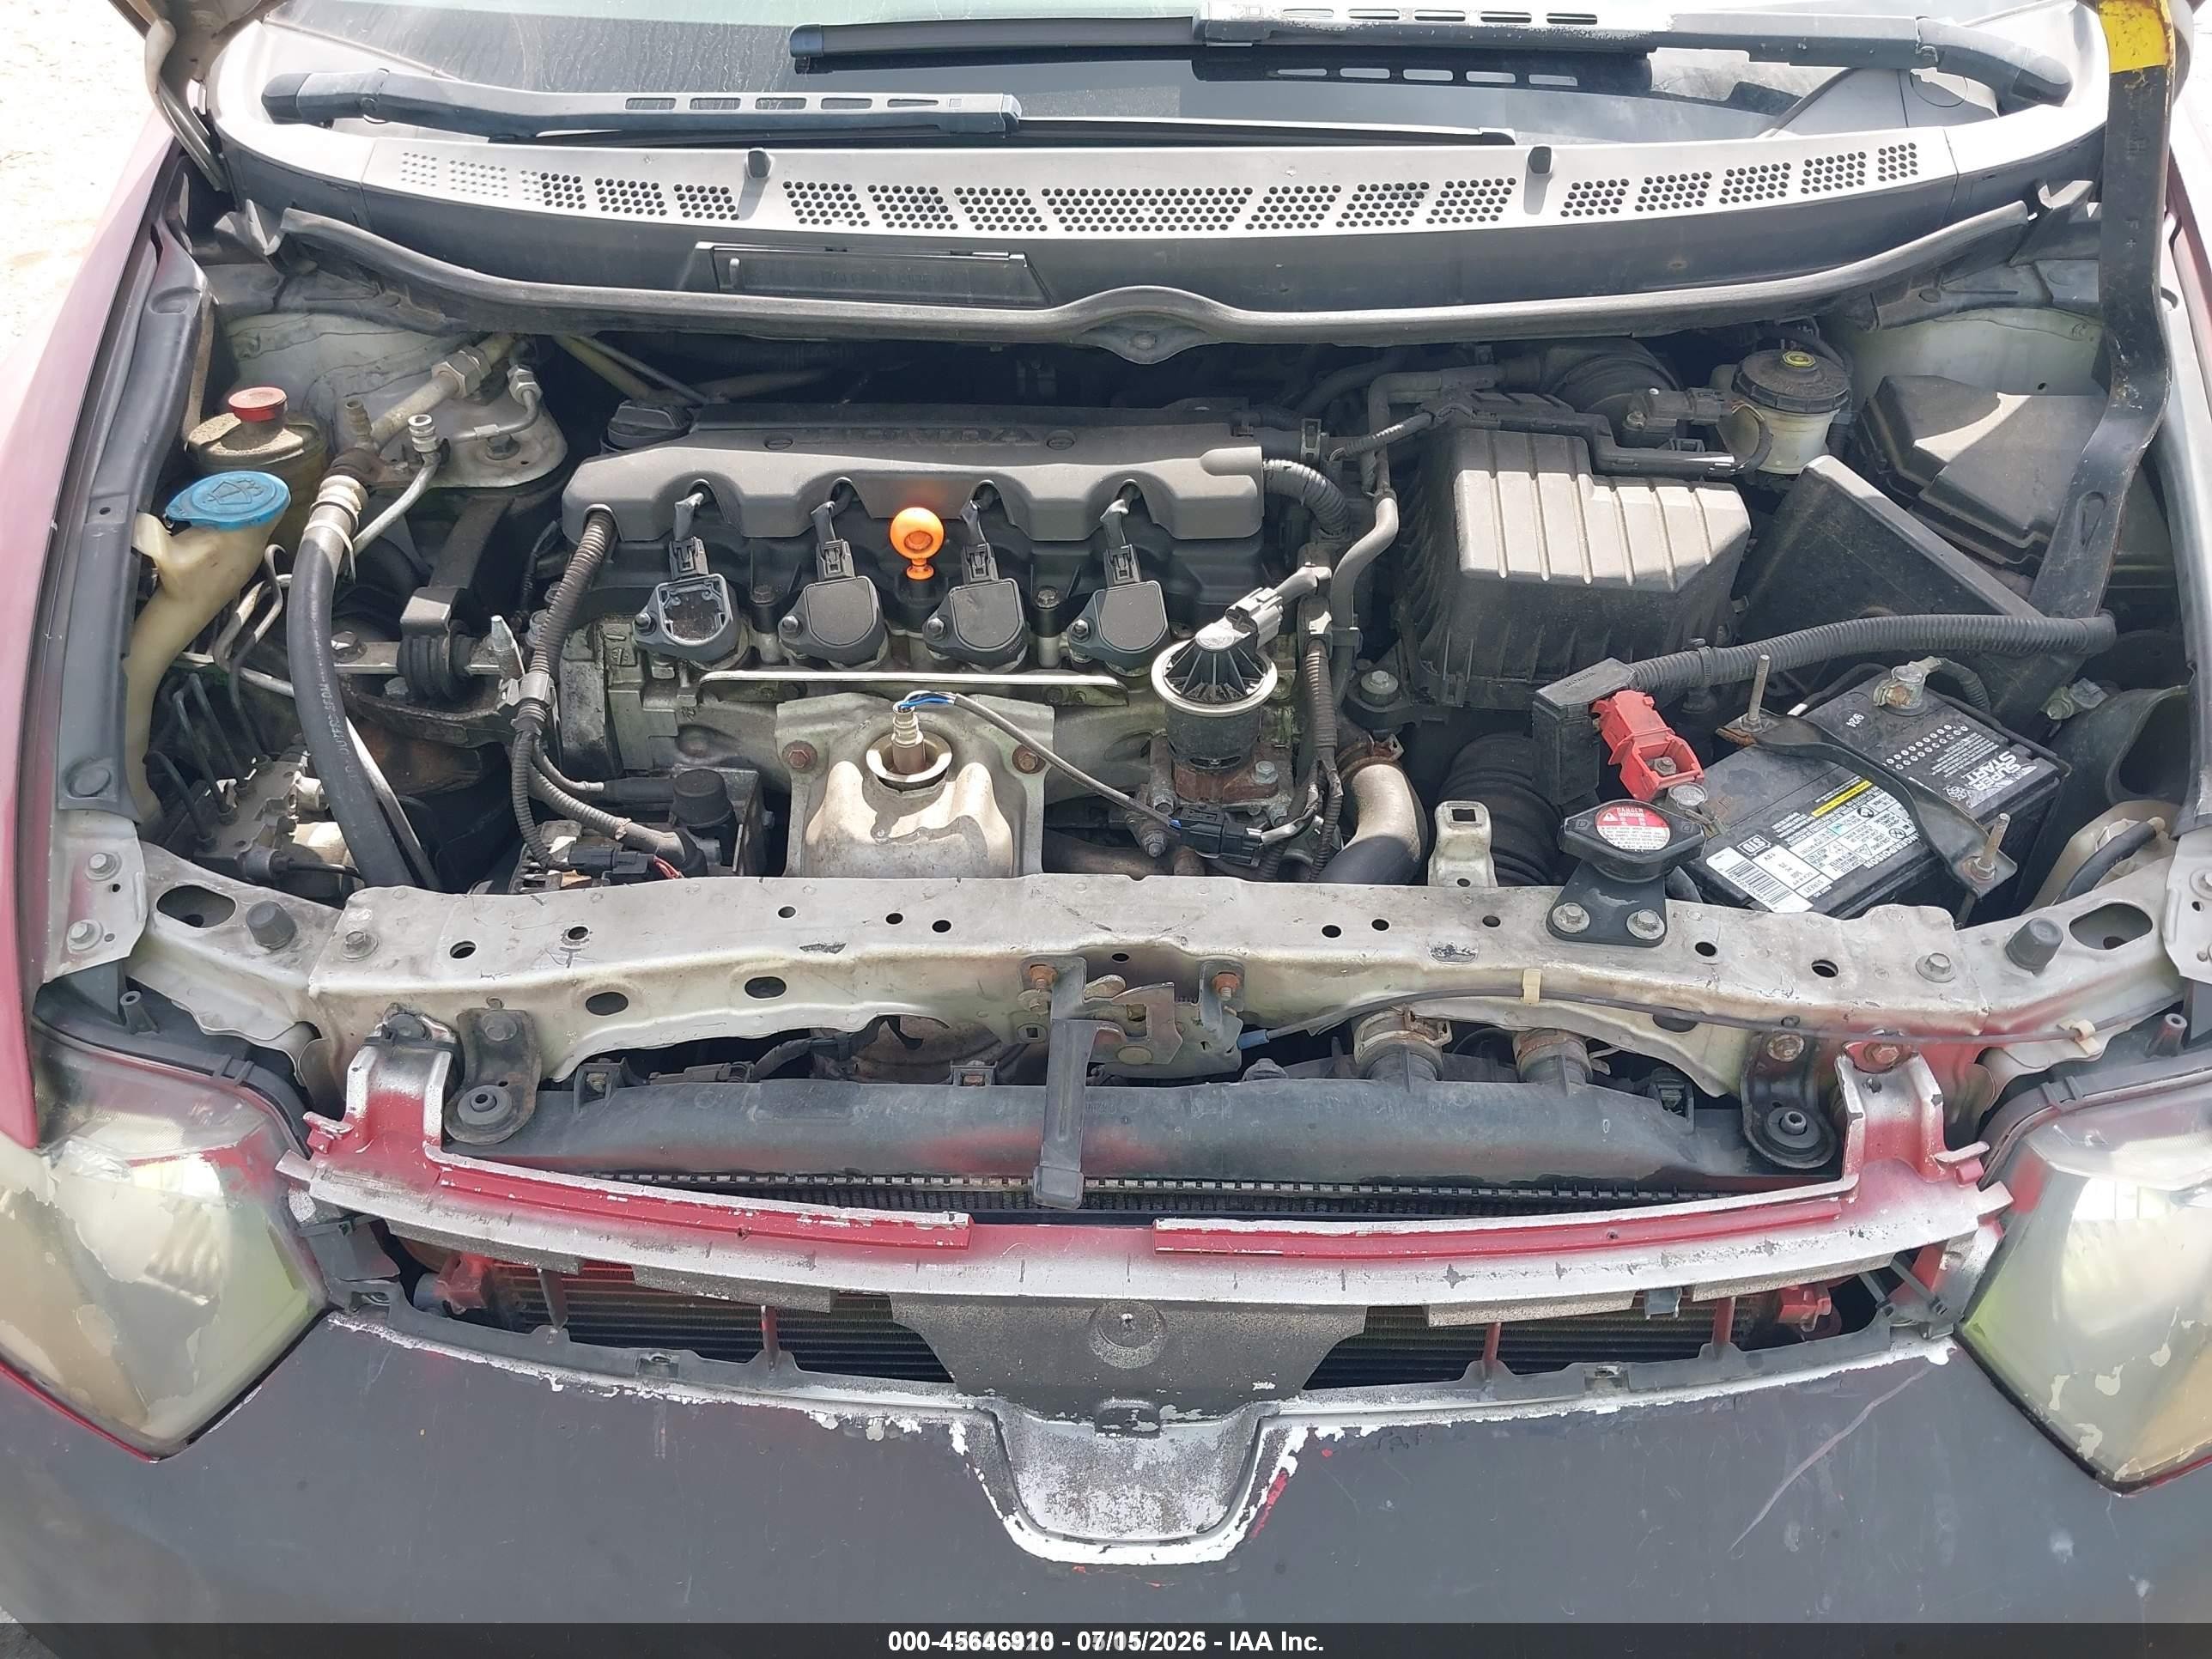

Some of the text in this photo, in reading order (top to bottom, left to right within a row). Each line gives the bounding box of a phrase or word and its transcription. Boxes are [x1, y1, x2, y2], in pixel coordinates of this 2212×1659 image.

[1846, 713, 1864, 728] 9/24
[1966, 751, 2016, 785] START
[1972, 759, 2021, 790] SUPER
[1742, 838, 1766, 853] STD
